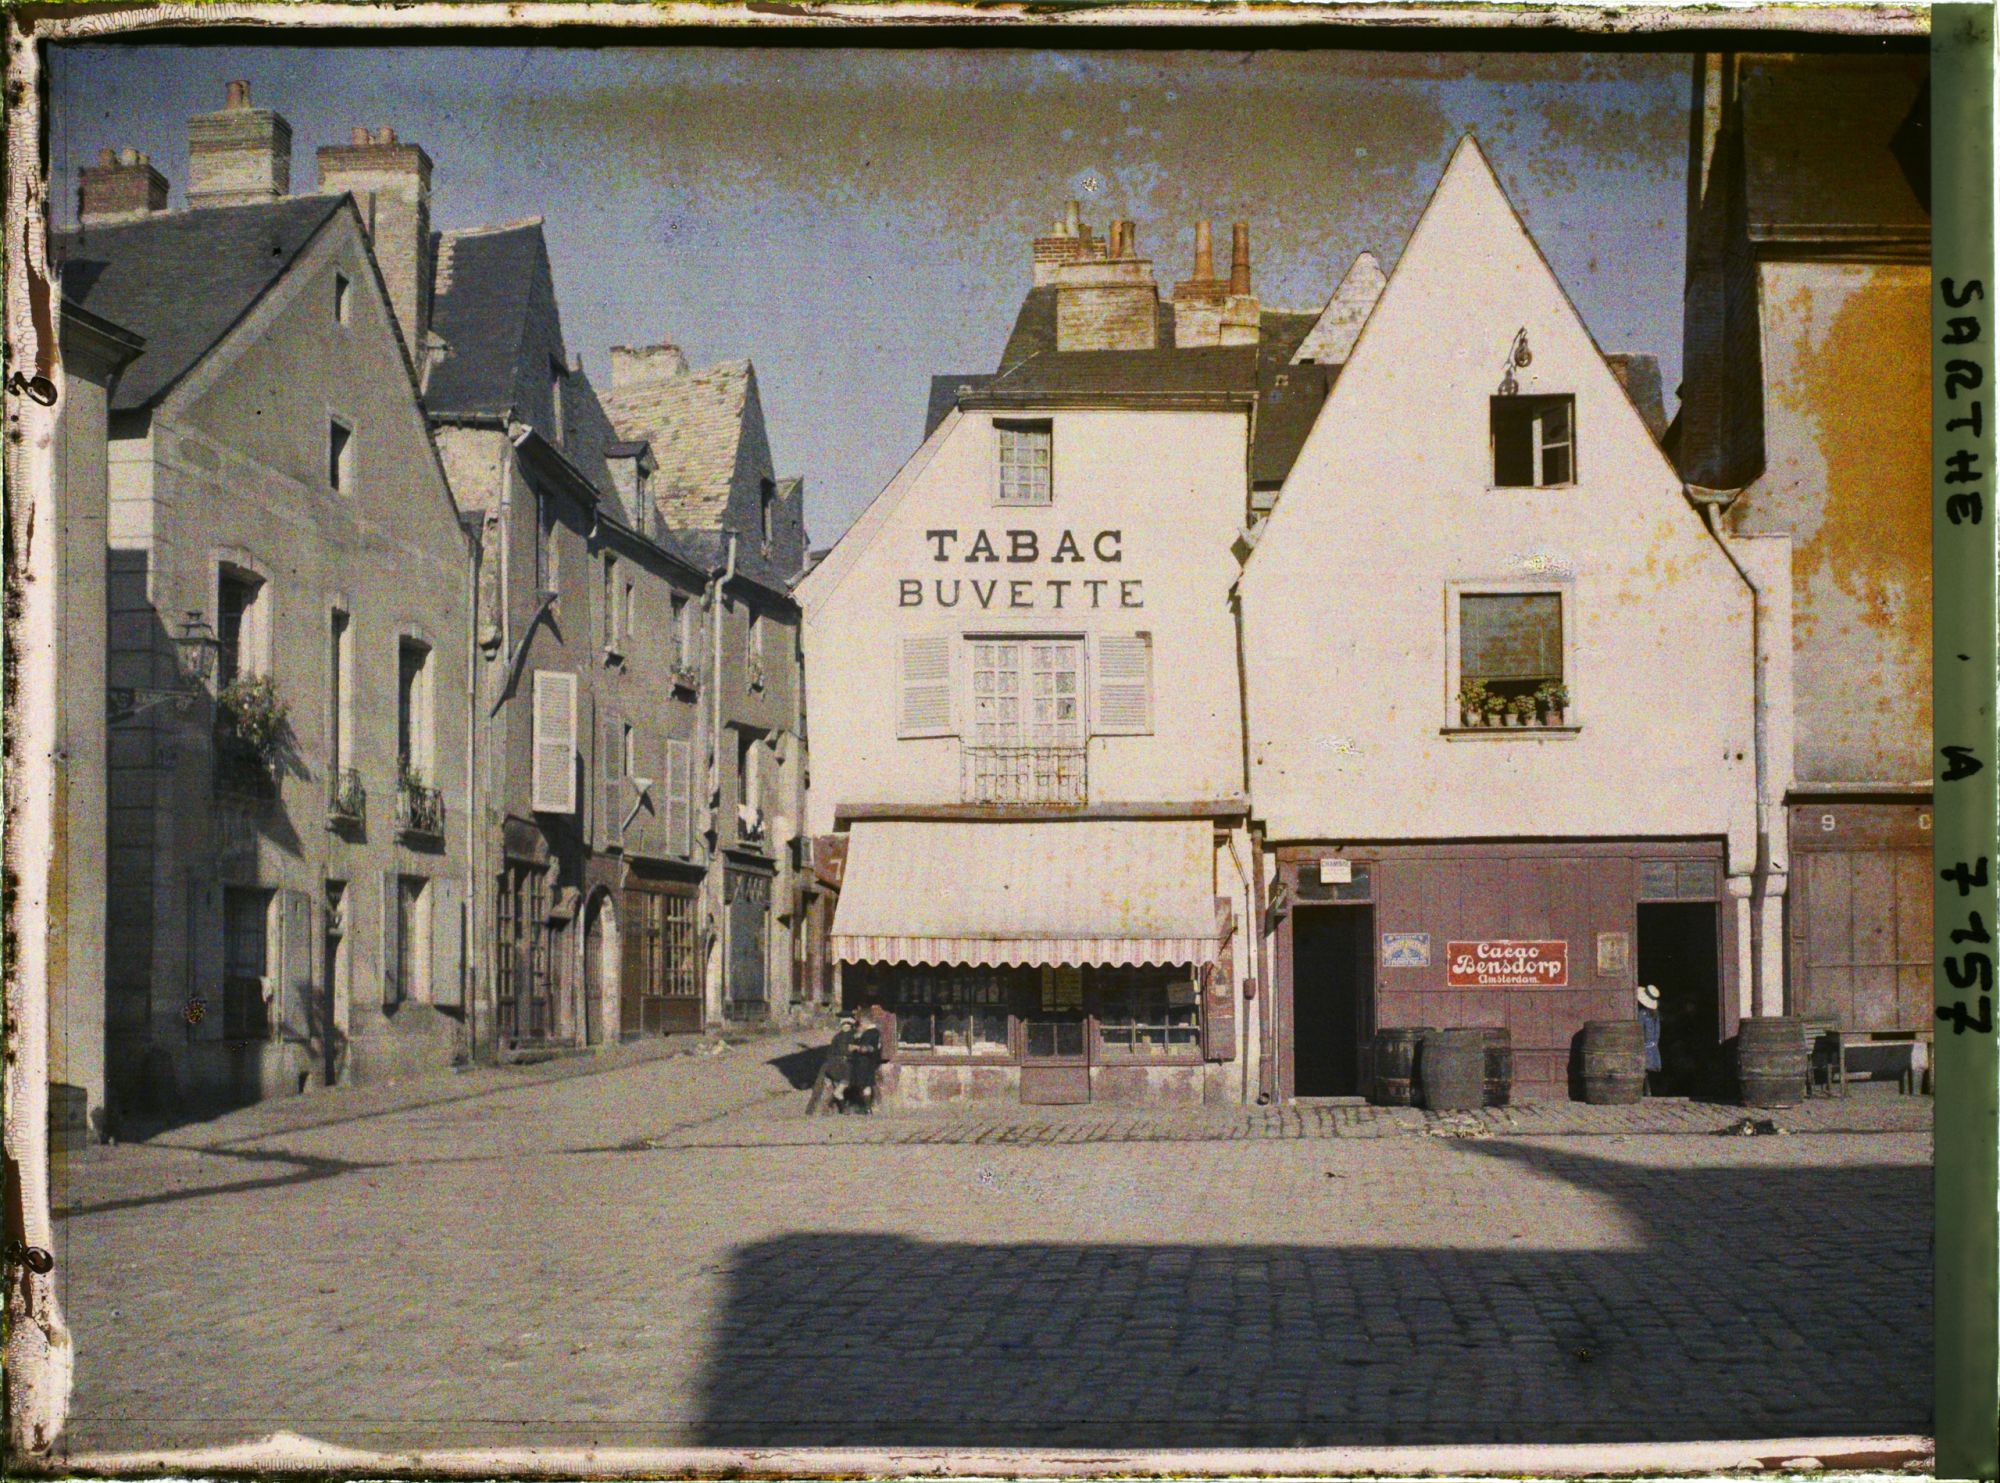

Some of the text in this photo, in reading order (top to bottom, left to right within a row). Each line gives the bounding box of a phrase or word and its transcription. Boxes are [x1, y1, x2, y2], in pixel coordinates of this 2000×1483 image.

[926, 529, 1122, 563] TABAC
[898, 579, 1144, 609] BUVETTE
[1935, 277, 1993, 1035] SARTHE A 7157
[1477, 943, 1540, 958] Cacao
[1452, 954, 1562, 978] Bensdorp
